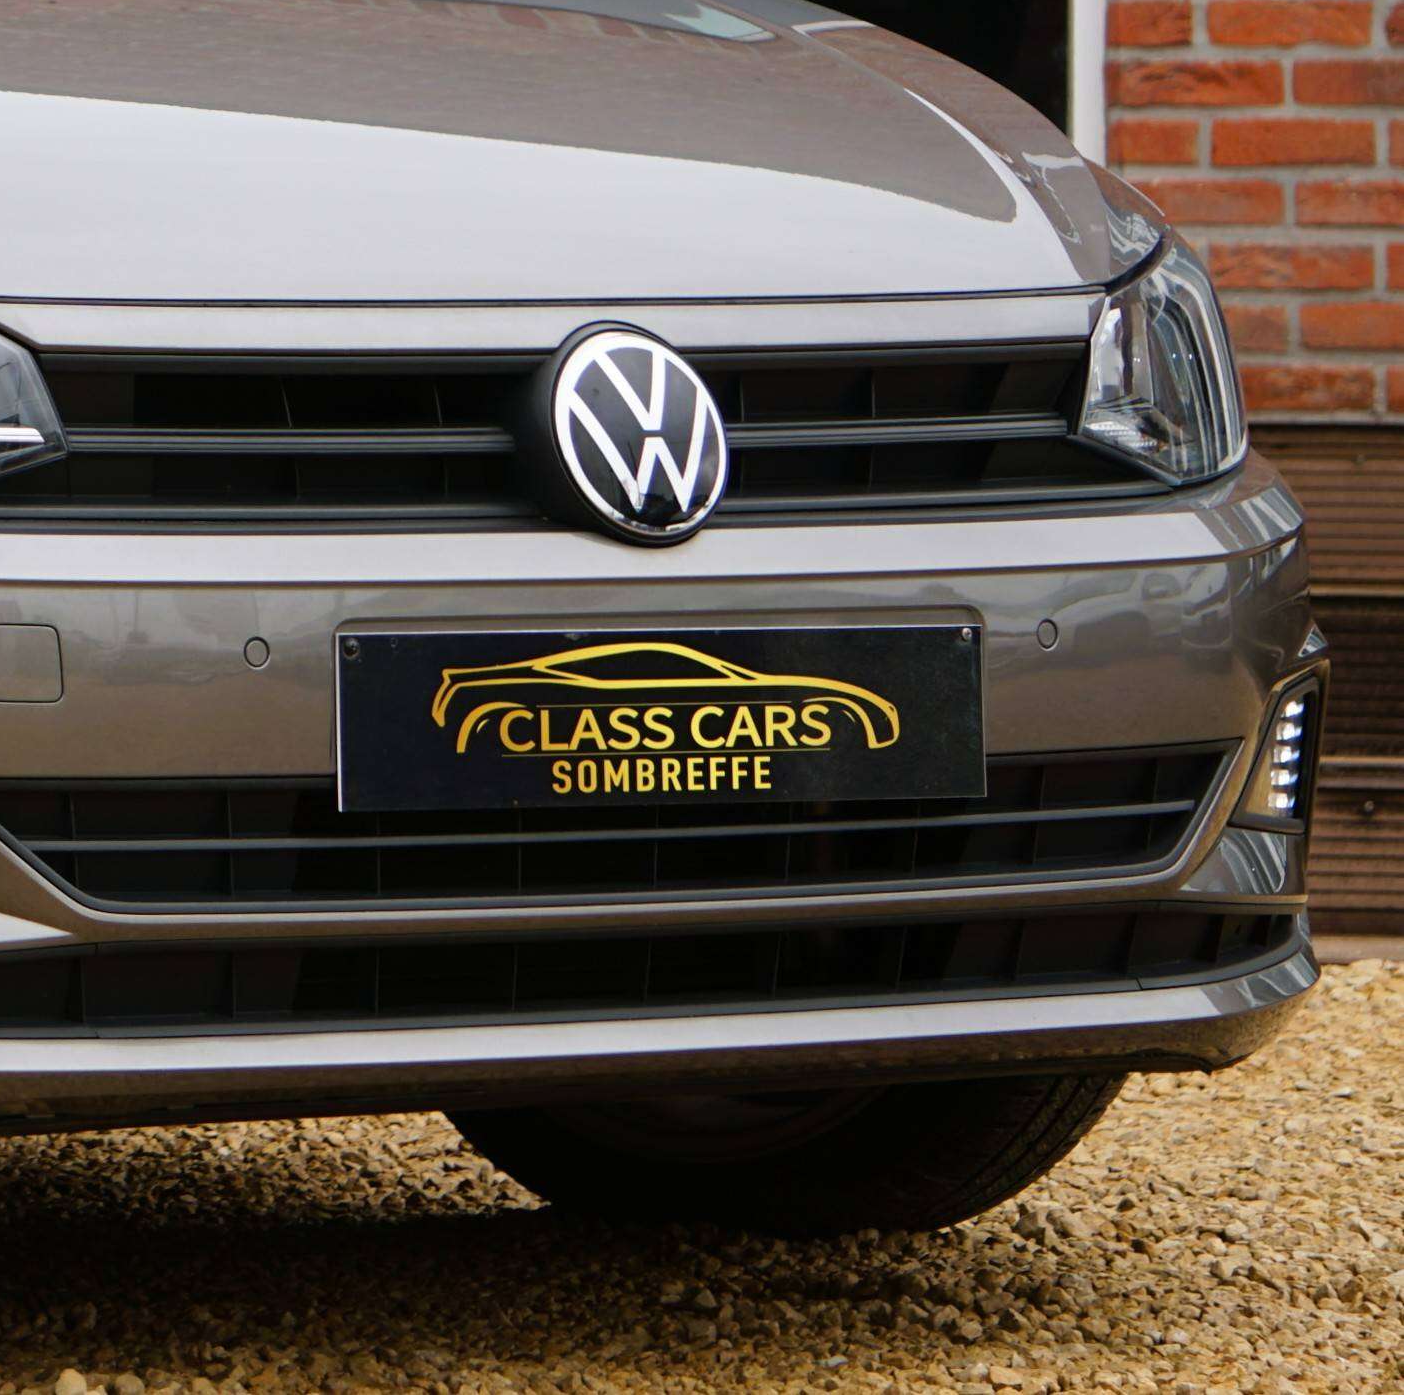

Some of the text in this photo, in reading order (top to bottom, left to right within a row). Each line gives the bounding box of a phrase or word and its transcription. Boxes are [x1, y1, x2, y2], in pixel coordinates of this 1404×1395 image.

[499, 704, 832, 753] CLASS CARS
[551, 755, 773, 795] SOMBREFFE
